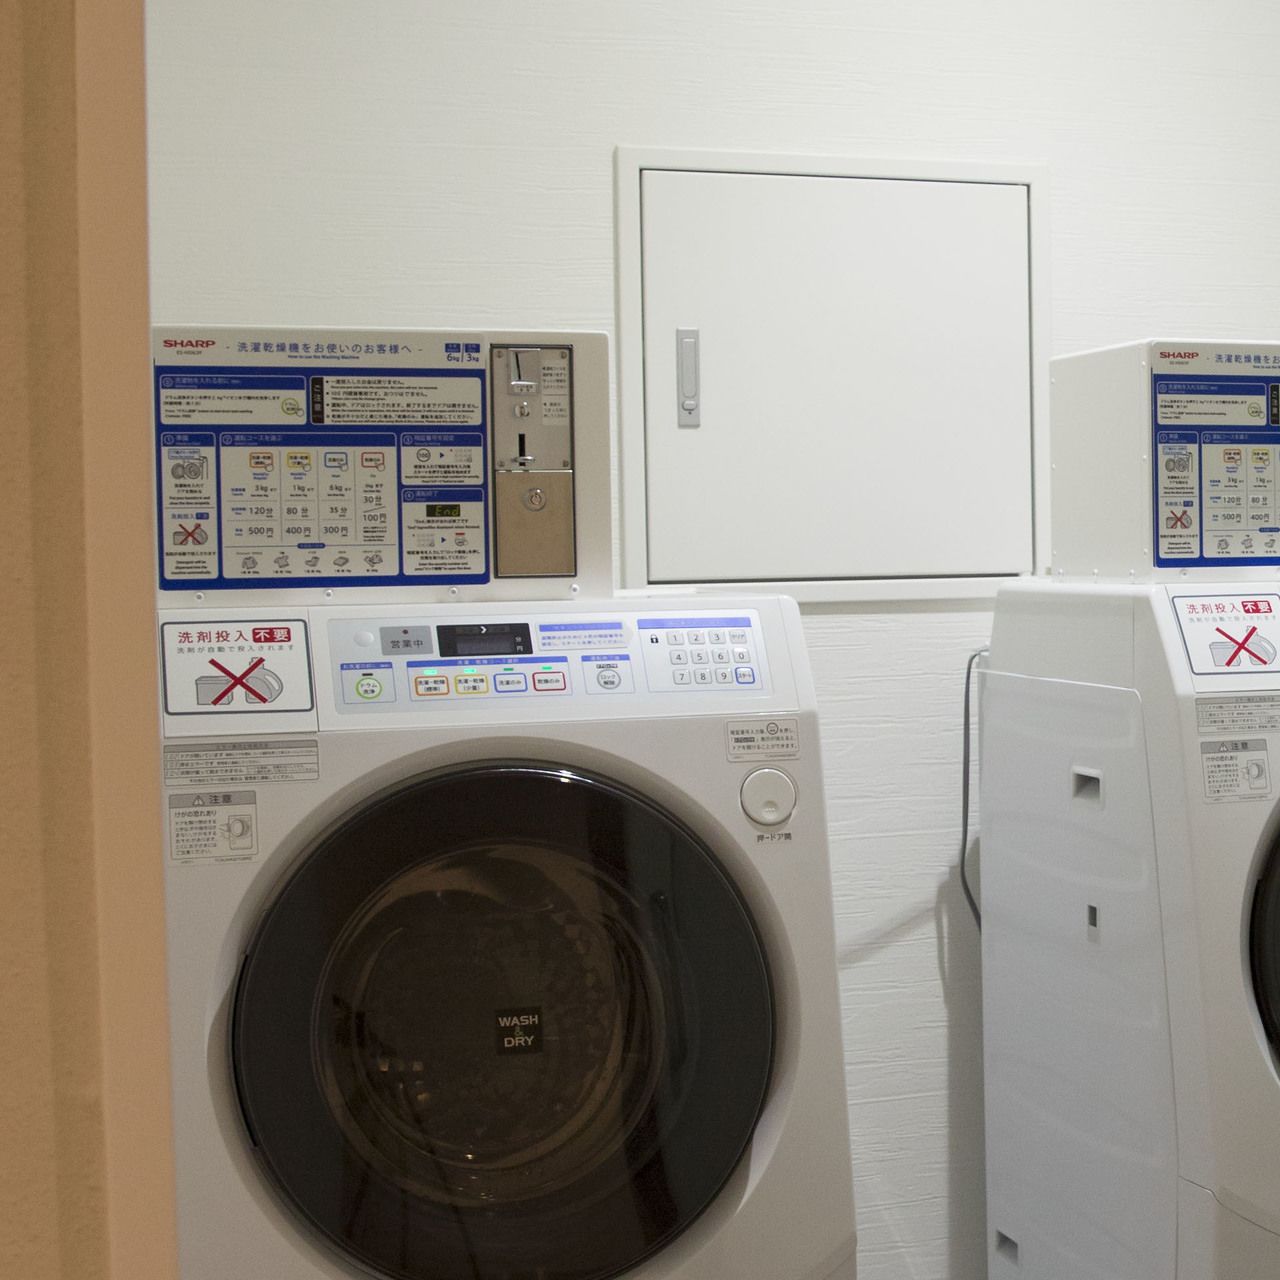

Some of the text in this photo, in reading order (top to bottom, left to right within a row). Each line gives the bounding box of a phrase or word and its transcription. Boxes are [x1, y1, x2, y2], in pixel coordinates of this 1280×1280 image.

[163, 339, 216, 349] SHARP
[237, 341, 412, 355] 洗濯乾燥機をお使いのお客様へ
[1159, 351, 1199, 359] SHARP
[435, 506, 459, 516] End
[1187, 602, 1271, 614] 洗剤投入 不要
[178, 628, 290, 644] 洗剤投入 不要
[390, 638, 425, 649] 営業中
[177, 644, 294, 655] 洗剤が自動で投入されます
[675, 654, 682, 662] 4
[696, 653, 703, 661] 5
[717, 652, 724, 661] 6
[738, 652, 745, 660] 0
[679, 673, 685, 682] 7
[700, 672, 707, 681] 8
[721, 672, 728, 680] 9
[209, 795, 232, 804] 注意
[499, 1015, 538, 1027] WASH
[504, 1036, 534, 1048] DRY
